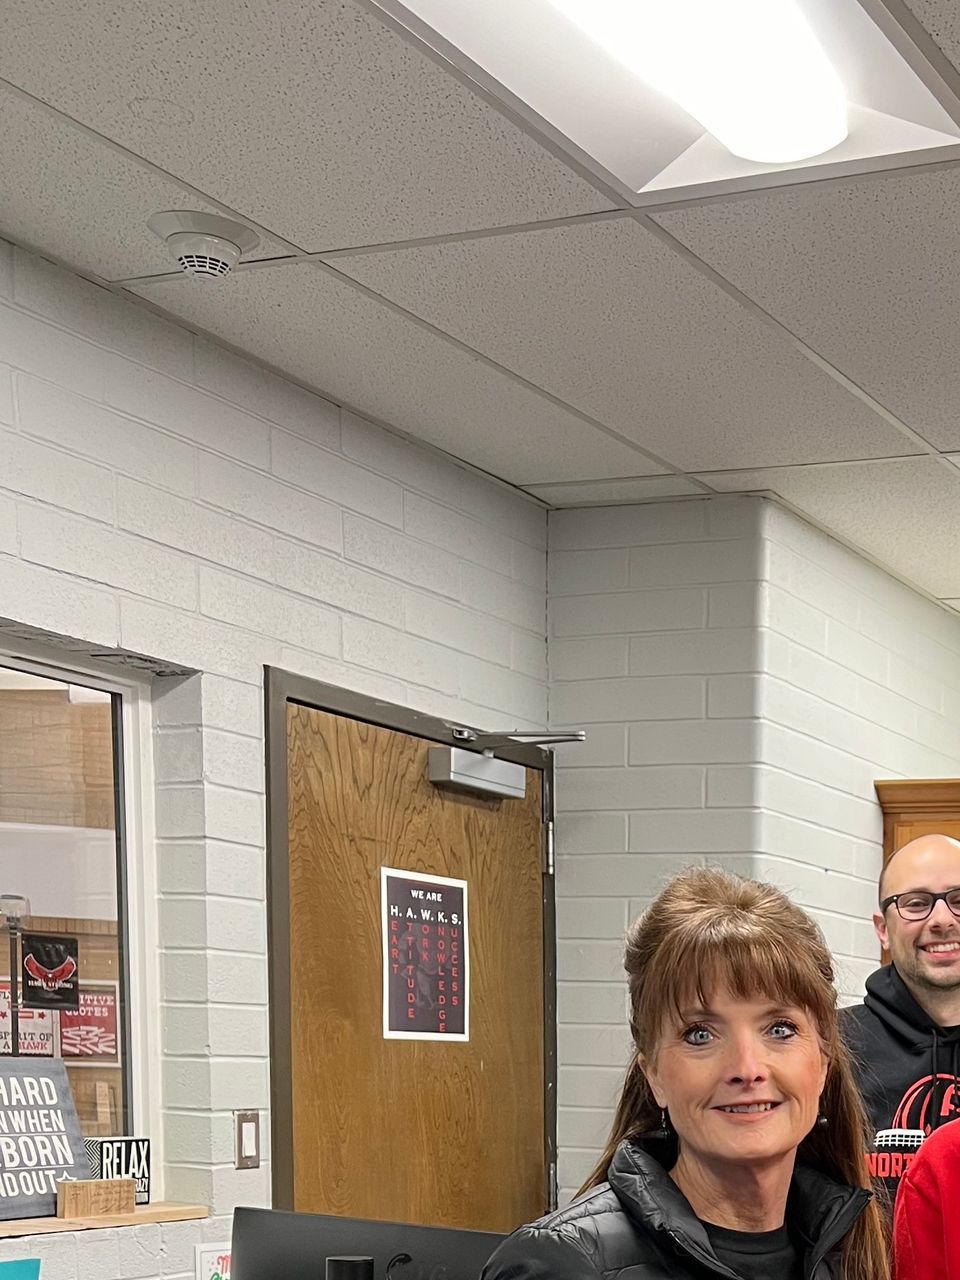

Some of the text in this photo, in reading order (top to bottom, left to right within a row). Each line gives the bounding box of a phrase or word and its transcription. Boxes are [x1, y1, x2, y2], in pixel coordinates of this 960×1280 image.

[411, 889, 442, 902] WE ARE
[80, 994, 114, 1005] ITIVE
[0, 1031, 53, 1041] SPRIT OF
[3, 1042, 48, 1050] A HAWK
[7, 1109, 66, 1133] WHEN
[0, 1134, 74, 1168] BORN
[102, 1140, 149, 1180] RELAX
